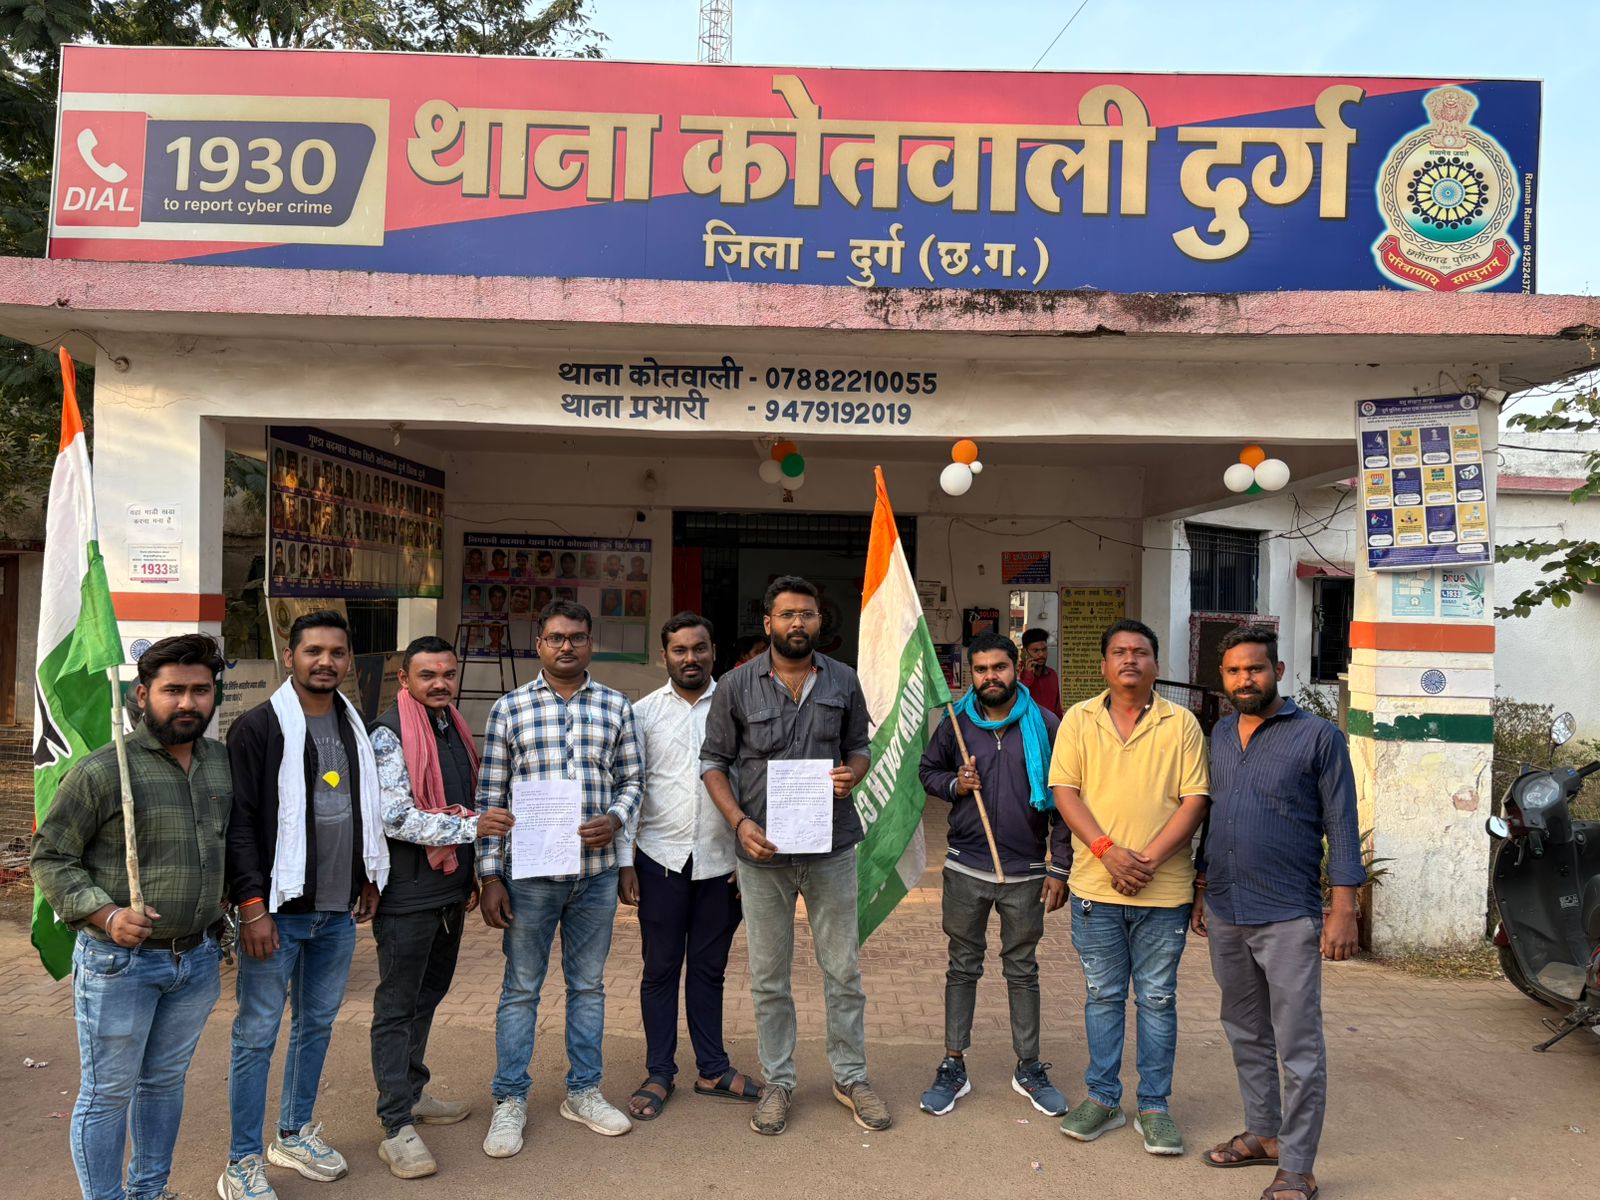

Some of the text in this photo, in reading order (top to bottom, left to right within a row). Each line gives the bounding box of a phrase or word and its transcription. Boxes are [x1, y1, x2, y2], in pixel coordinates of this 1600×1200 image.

[166, 137, 337, 195] 1930
[406, 75, 1366, 261] थाना कोतवाली दुर्ग
[63, 187, 135, 212] DIAL
[164, 197, 333, 215] to report cyber crime
[1525, 173, 1533, 205] Raman
[1523, 208, 1532, 242] Radium
[703, 219, 803, 271] जिला
[847, 223, 906, 287] दुर्ग
[919, 234, 1050, 286] (छ.ग.)
[1387, 251, 1441, 286] परित्राणाय
[1452, 252, 1480, 266] पुलिस
[558, 362, 624, 388] थाना
[629, 356, 744, 391] कोतवाली
[765, 367, 938, 395] 07882210055
[560, 393, 624, 419] थाना
[629, 389, 709, 421] प्रभारी
[765, 400, 912, 425] 9479192019
[141, 563, 168, 575] 1933
[1443, 575, 1466, 583] DRUG
